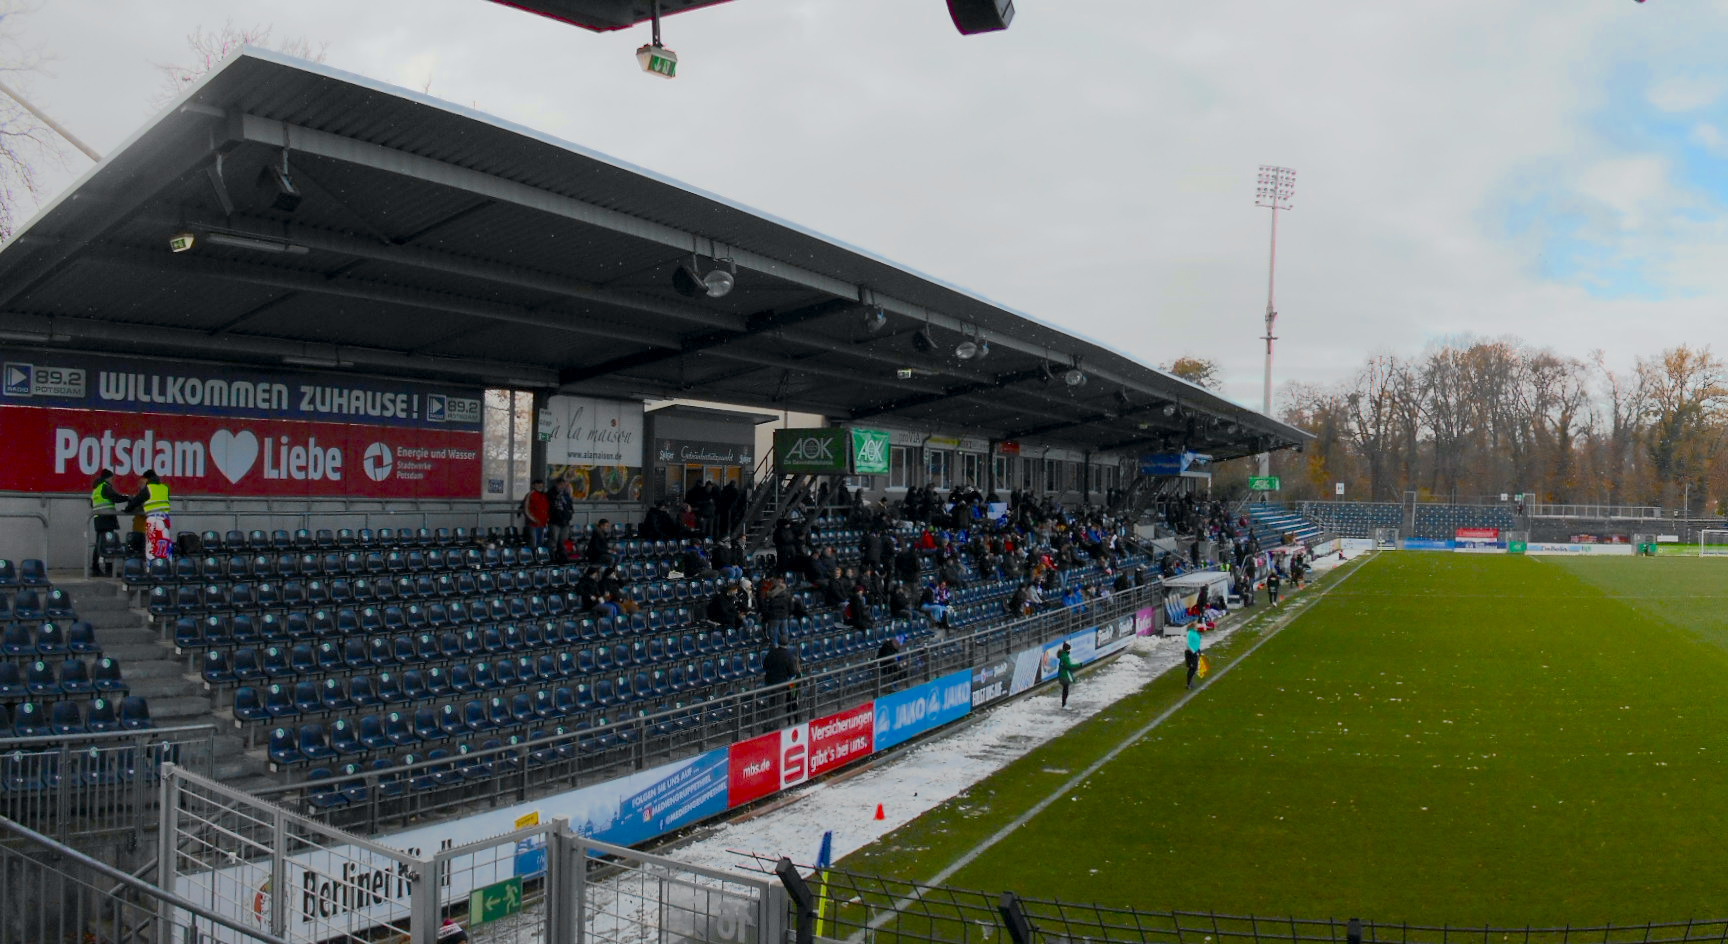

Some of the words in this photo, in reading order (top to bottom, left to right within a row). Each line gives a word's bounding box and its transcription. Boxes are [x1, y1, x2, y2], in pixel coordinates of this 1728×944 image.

[35, 370, 81, 386] 89.2
[35, 386, 81, 394] POTSDAM
[99, 371, 289, 410] WILLKOMMEN
[447, 400, 478, 413] 89.2
[54, 427, 205, 478] Potsdam
[263, 436, 343, 482] Liebe
[396, 447, 429, 460] Energie
[430, 449, 446, 459] und
[448, 449, 476, 460] Wasser
[785, 437, 834, 460] AOK
[857, 439, 884, 462] AOK
[396, 471, 424, 480] Potsdam
[893, 697, 926, 729] JAKO
[942, 681, 971, 711] JAKO
[810, 710, 873, 741] Versicherungen
[810, 745, 836, 773] gibt's
[836, 742, 850, 760] bei
[850, 736, 868, 753] uns.
[742, 757, 771, 779] mbs.de
[631, 787, 657, 808] FOLGEN
[657, 782, 667, 793] SIE
[666, 775, 680, 789] UNS
[680, 767, 693, 782] AUF
[302, 861, 393, 923] Berliner
